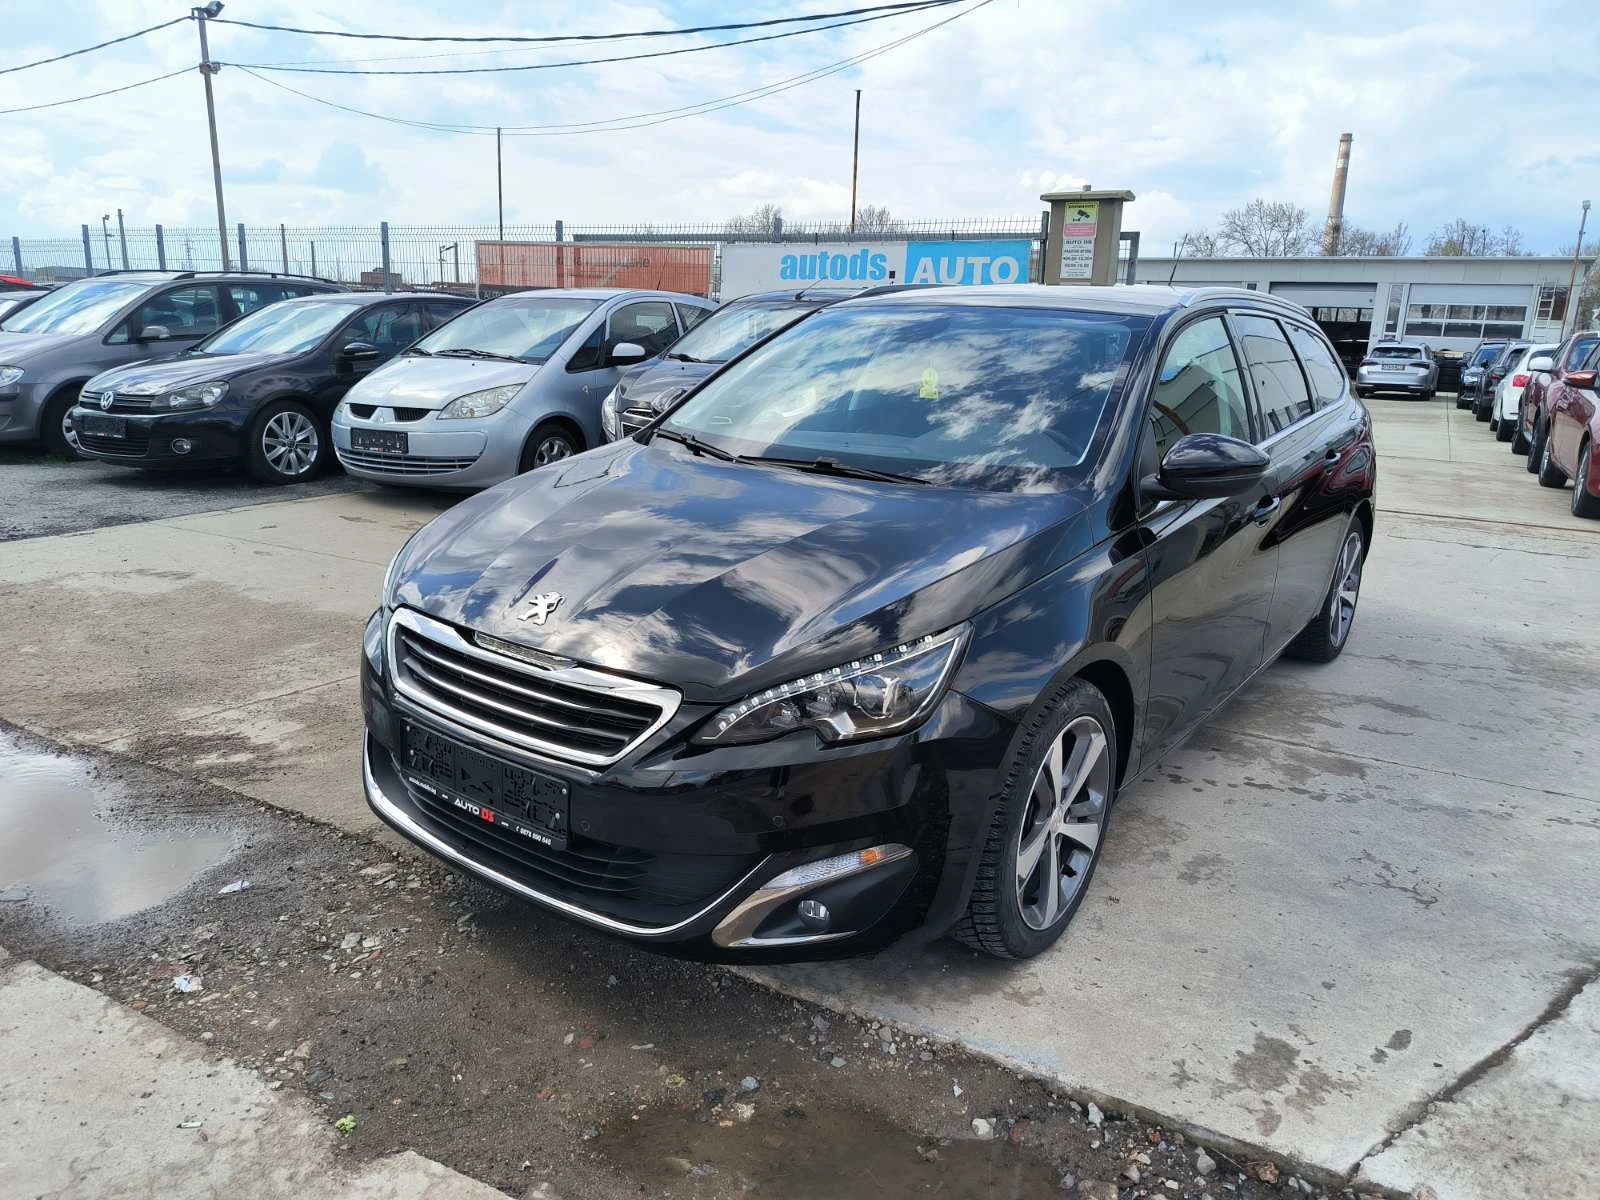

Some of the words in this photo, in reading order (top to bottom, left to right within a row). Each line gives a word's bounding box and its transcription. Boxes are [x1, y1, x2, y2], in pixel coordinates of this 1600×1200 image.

[780, 248, 887, 281] autods
[911, 255, 1019, 286] AUTO
[453, 797, 480, 815] AUTO
